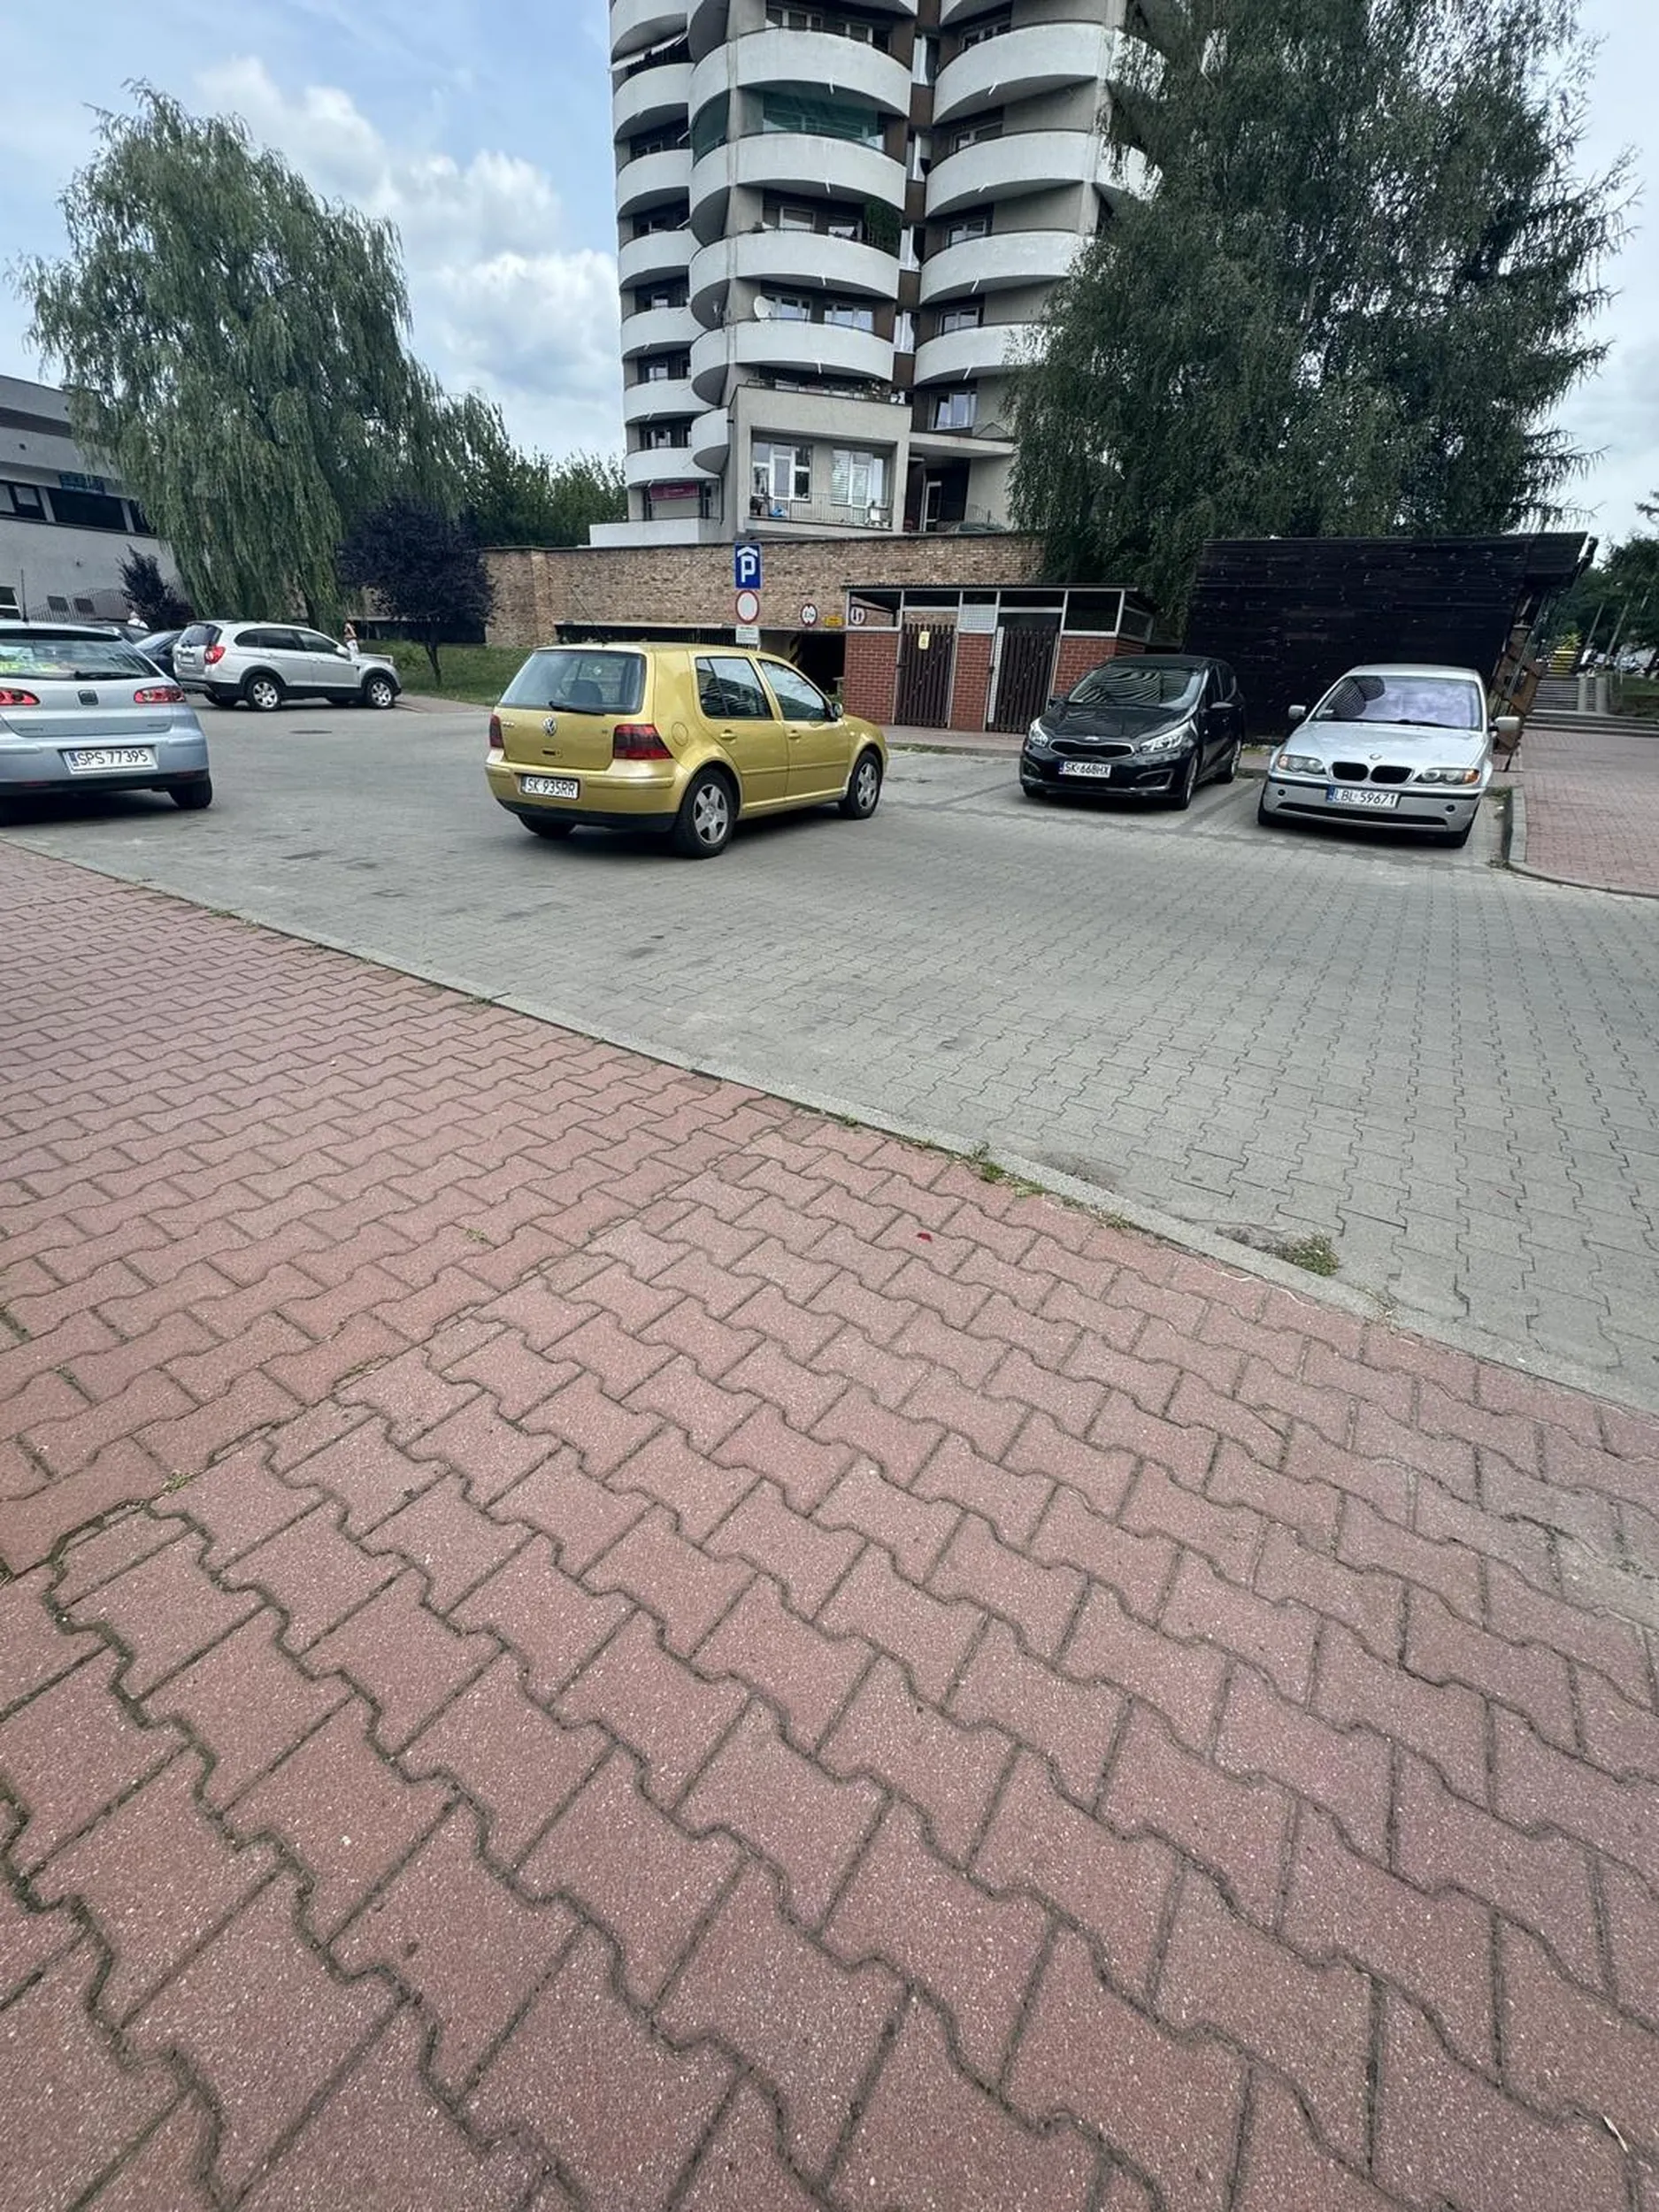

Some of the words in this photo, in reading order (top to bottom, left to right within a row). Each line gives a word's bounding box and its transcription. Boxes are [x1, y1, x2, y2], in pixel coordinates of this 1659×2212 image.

[741, 556, 756, 583] P
[77, 750, 105, 766] SPS
[106, 749, 149, 764] 77395
[528, 778, 540, 792] SK
[1359, 791, 1395, 804] 59671
